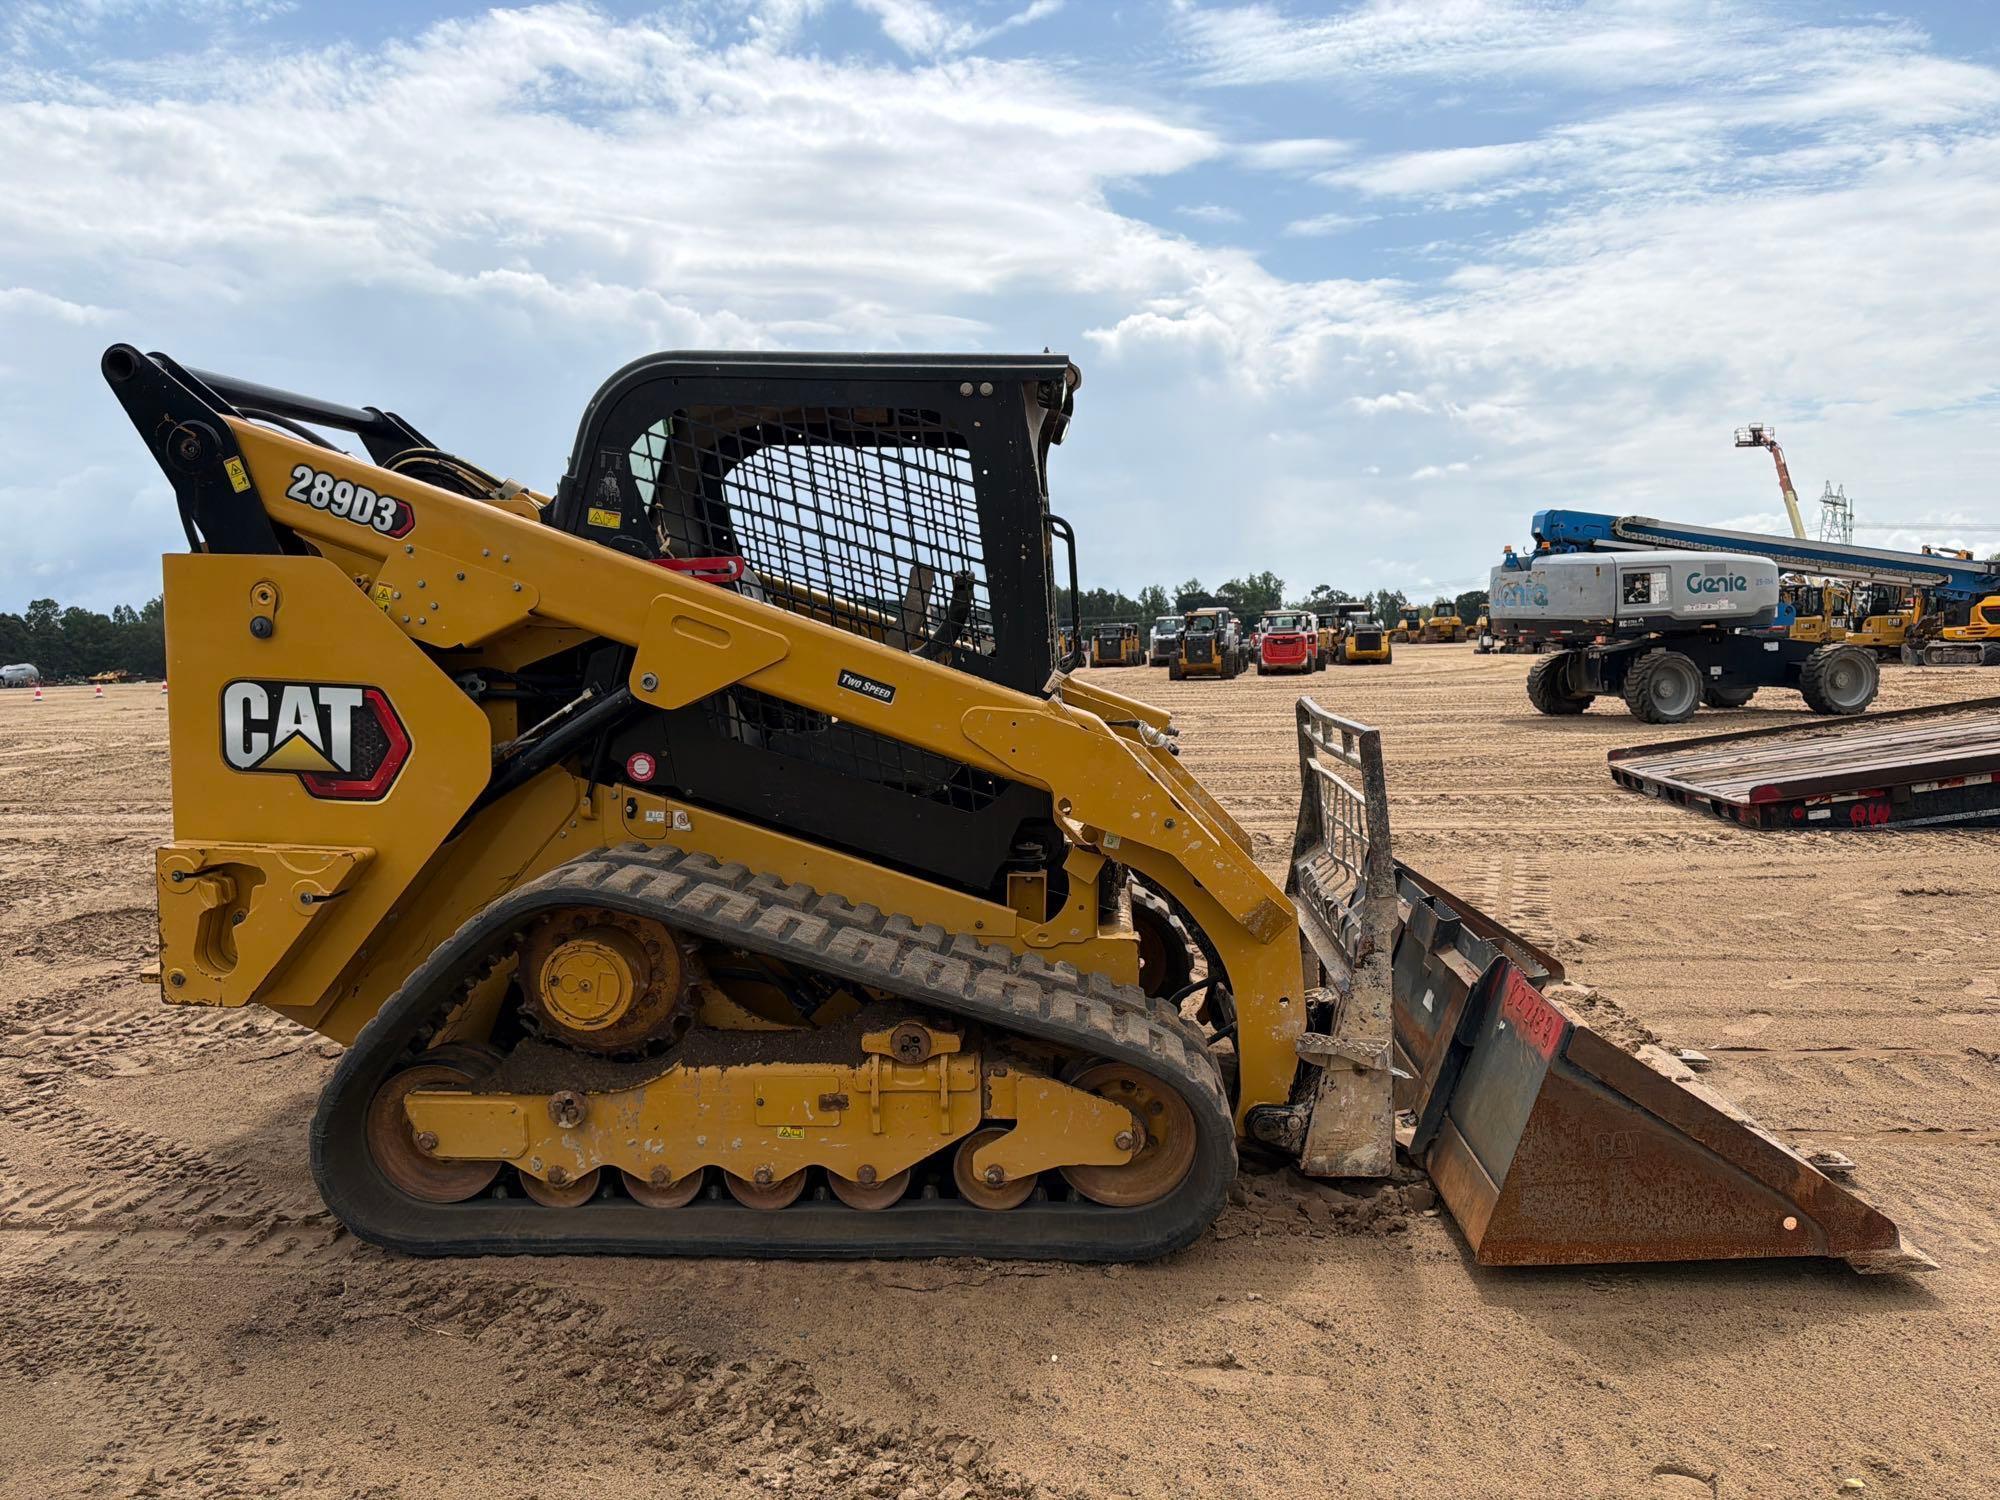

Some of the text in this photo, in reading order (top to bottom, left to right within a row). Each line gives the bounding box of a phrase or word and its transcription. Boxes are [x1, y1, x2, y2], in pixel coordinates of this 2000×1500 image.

[287, 464, 398, 532] 289D3
[1686, 571, 1748, 594] Genie
[1831, 618, 1847, 628] CAT
[224, 681, 364, 773] CAT
